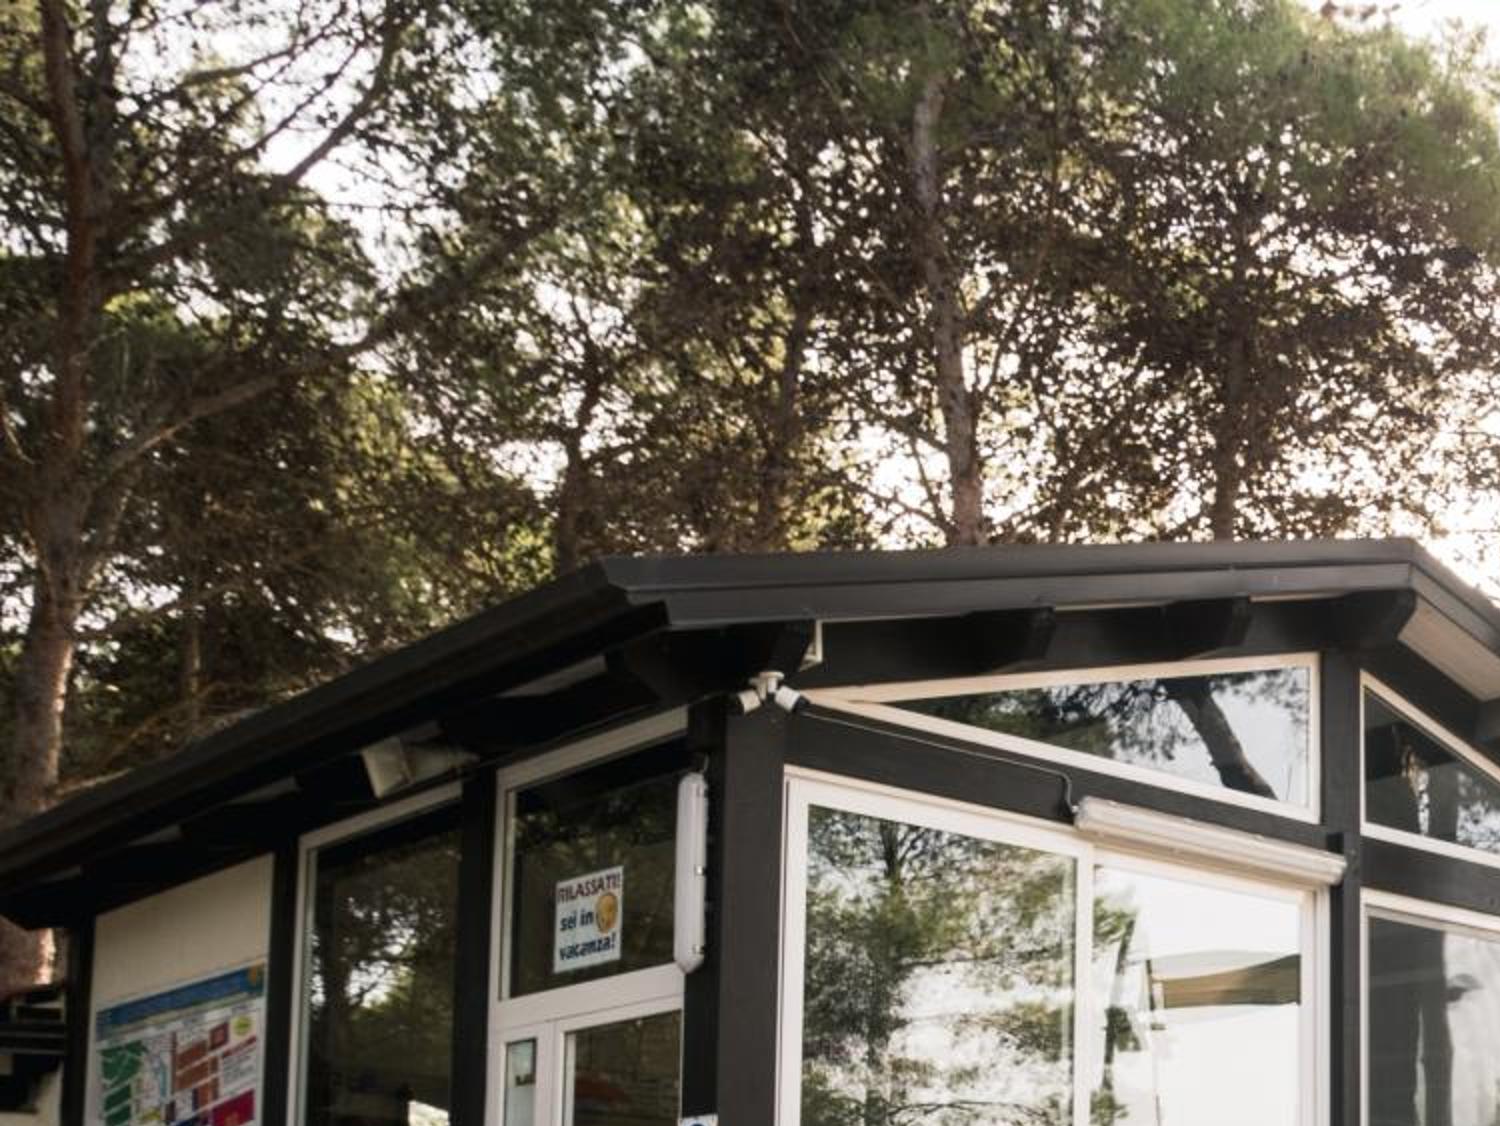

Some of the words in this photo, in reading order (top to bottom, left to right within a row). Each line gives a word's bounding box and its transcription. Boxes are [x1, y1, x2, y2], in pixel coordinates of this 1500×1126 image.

[560, 909, 577, 931] sei
[580, 906, 595, 927] in
[559, 932, 616, 960] vacanza!
